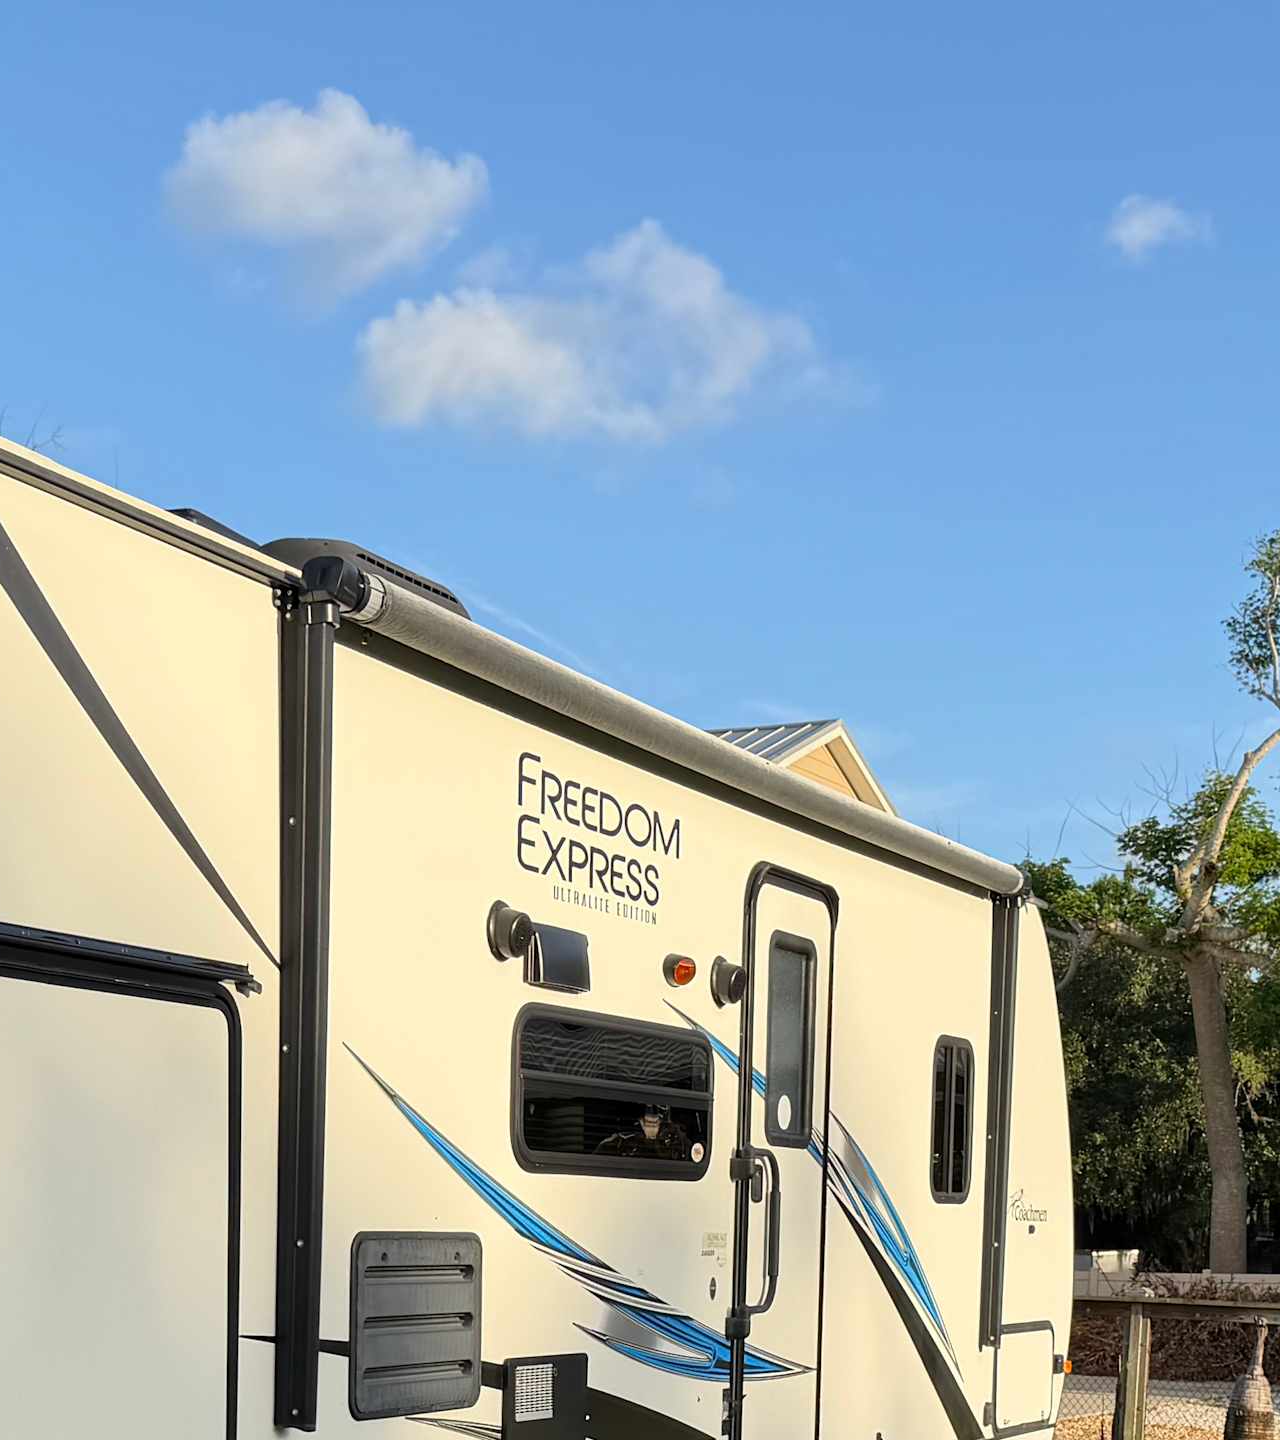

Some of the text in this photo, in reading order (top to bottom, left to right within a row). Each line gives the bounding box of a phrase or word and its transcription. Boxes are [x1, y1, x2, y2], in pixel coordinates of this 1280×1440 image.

[517, 751, 680, 860] FREEDOM
[517, 814, 660, 906] EXPRESS
[553, 885, 610, 914] ULTRALITE
[617, 901, 657, 925] EDITION
